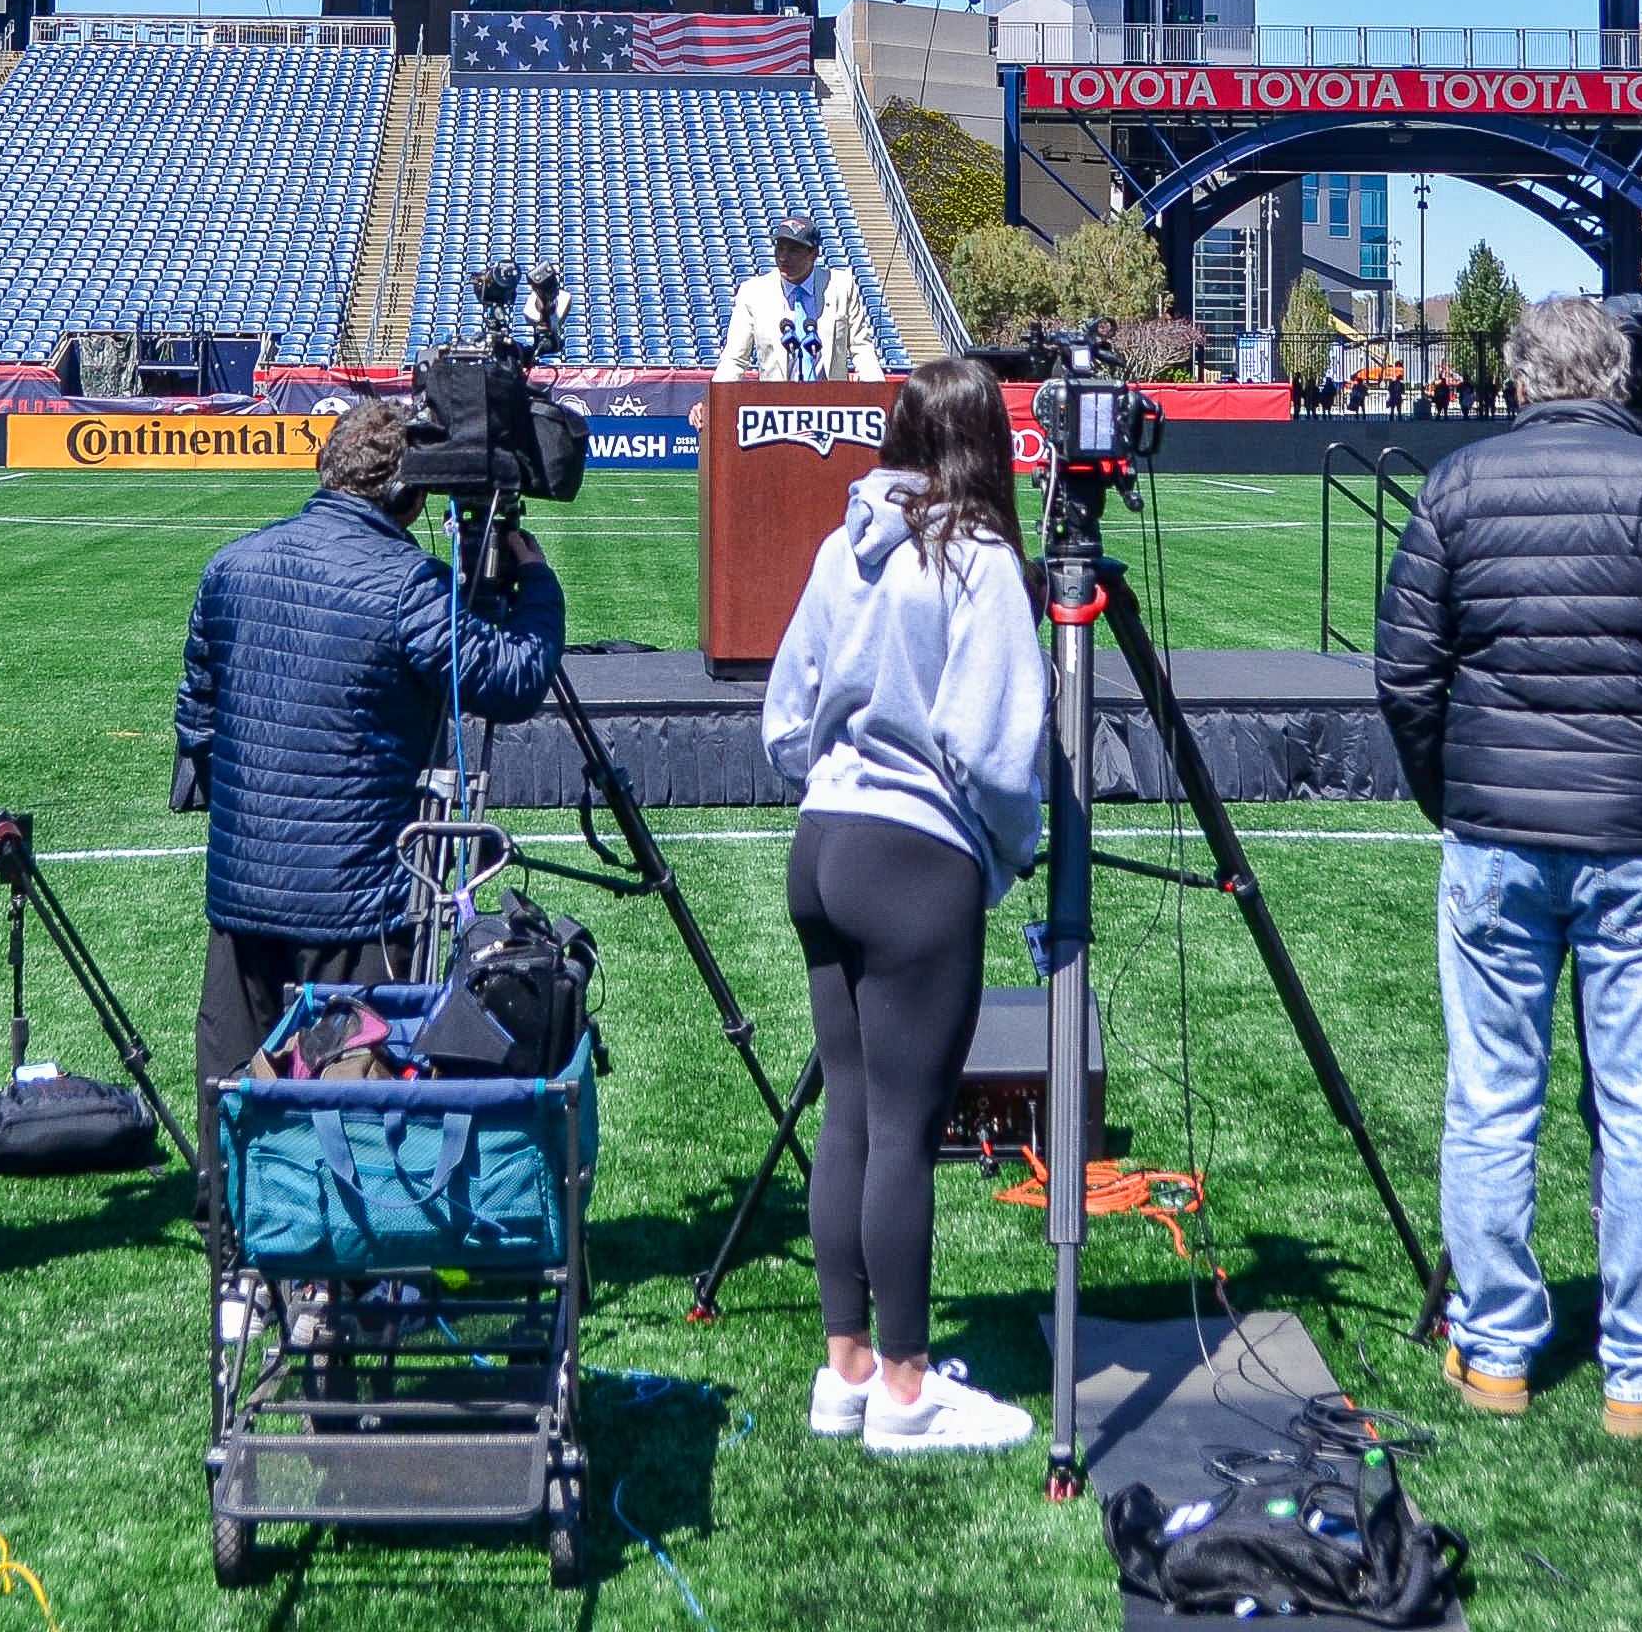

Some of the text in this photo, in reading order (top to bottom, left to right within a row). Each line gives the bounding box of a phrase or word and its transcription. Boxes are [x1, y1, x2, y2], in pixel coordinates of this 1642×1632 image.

[1044, 69, 1218, 109] TOYOTA
[1232, 71, 1404, 110] TOYOTA
[1419, 73, 1589, 112] TOYOTA
[66, 418, 286, 464] Continental
[741, 409, 883, 442] PATRIOTS
[586, 435, 666, 458] WASH
